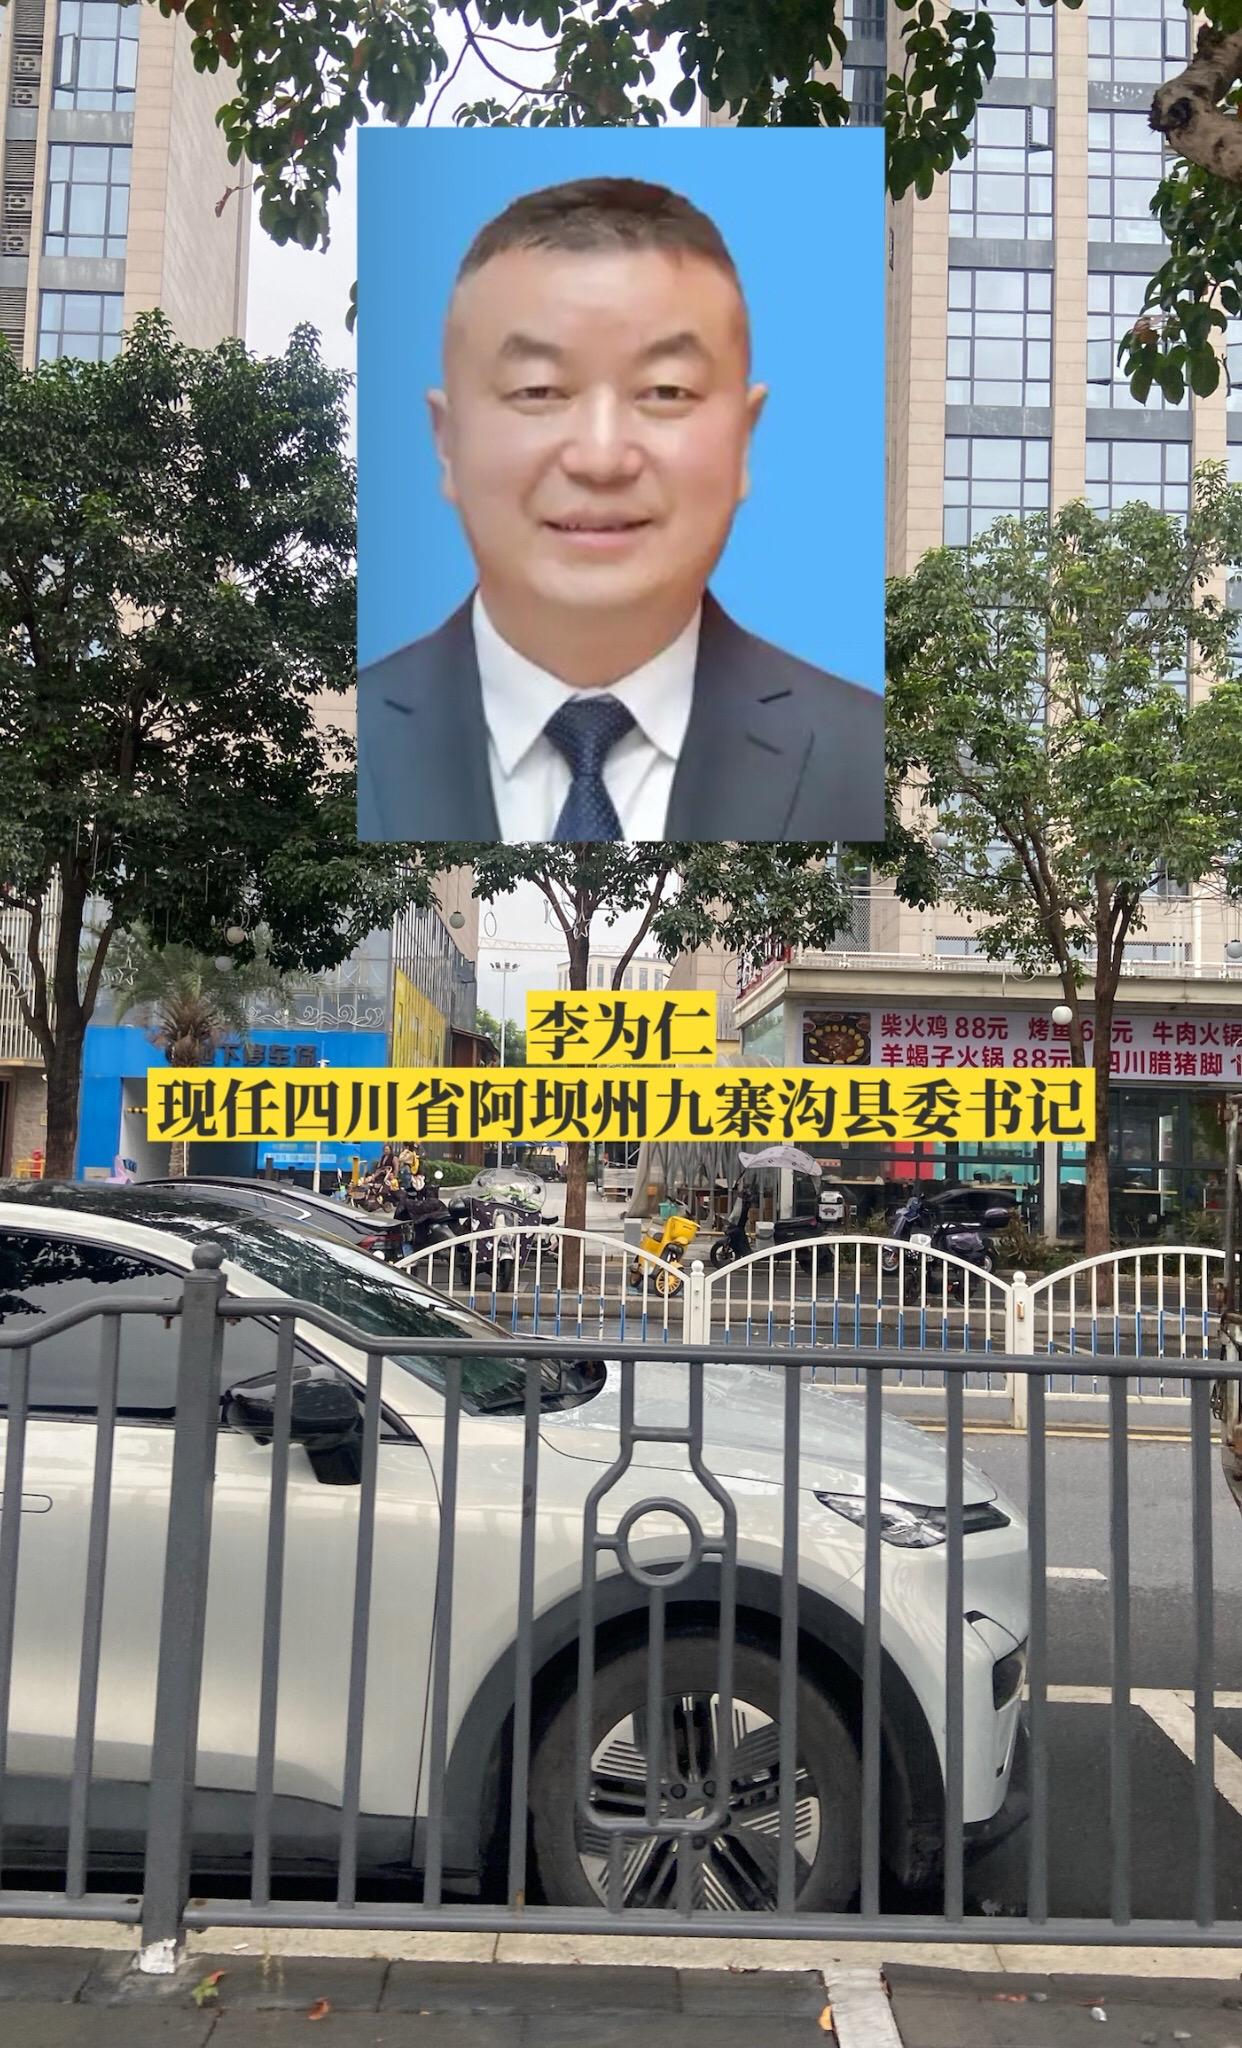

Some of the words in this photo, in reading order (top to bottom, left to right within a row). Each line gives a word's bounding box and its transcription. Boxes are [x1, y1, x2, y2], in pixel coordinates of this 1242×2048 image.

[881, 1014, 948, 1038] 柴火鸡
[955, 1016, 1008, 1040] 88元
[1080, 1019, 1133, 1043] 6元
[881, 1043, 1004, 1068] 羊蝎子火锅
